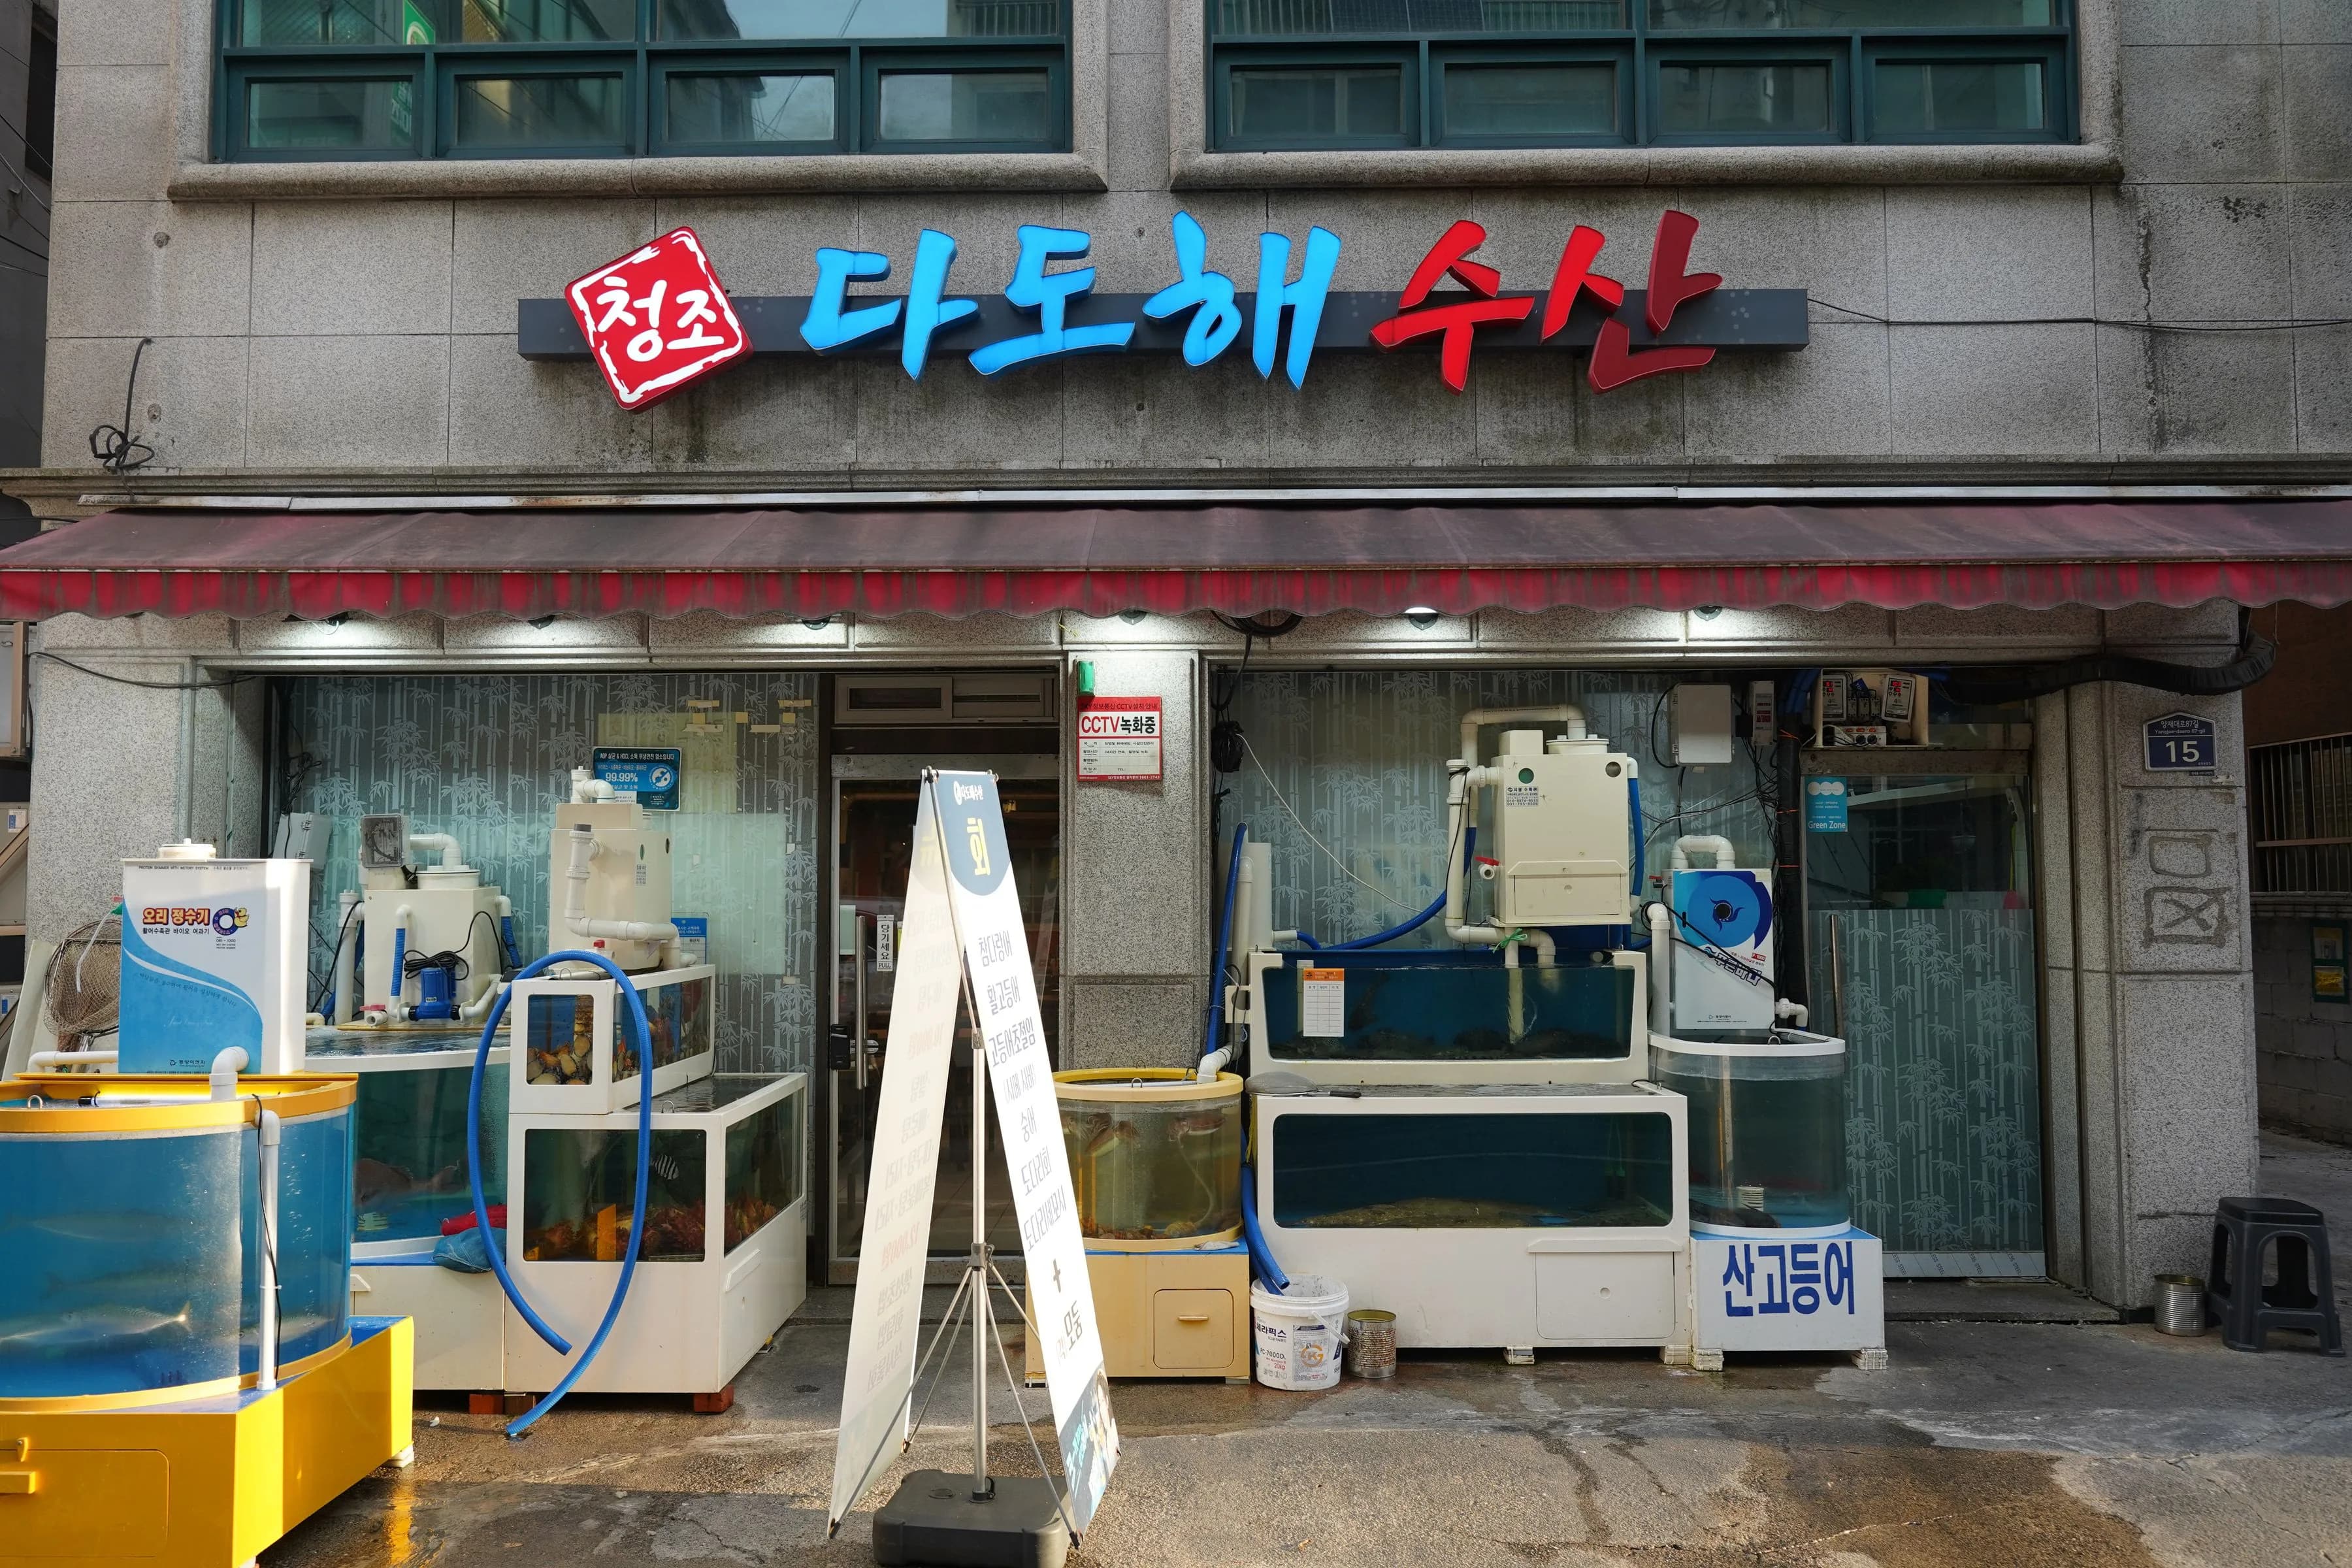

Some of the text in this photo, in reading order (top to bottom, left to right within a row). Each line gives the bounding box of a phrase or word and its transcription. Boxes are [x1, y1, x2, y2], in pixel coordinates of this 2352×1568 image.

[597, 276, 725, 361] 청조
[799, 210, 1723, 395] 다도해 수산
[1081, 716, 1156, 734] CCTV녹화중
[2161, 720, 2199, 728] 양재대로87길
[2166, 741, 2200, 762] 15
[606, 772, 638, 782] 99.99%
[967, 817, 990, 876] 회
[142, 907, 169, 925] 오리
[171, 907, 210, 926] 정수기
[881, 924, 889, 960] 당기세요
[978, 930, 1012, 967] 참다랑어
[987, 975, 1021, 1015] 활고등어
[988, 1017, 1036, 1067] 고등어초절임
[1021, 1105, 1037, 1143] 숭어
[1021, 1145, 1052, 1196] 도다리회
[1023, 1184, 1066, 1252] 도다리세꼬시
[1723, 1241, 1855, 1316] 산고등어
[1064, 1300, 1083, 1351] 모둠
